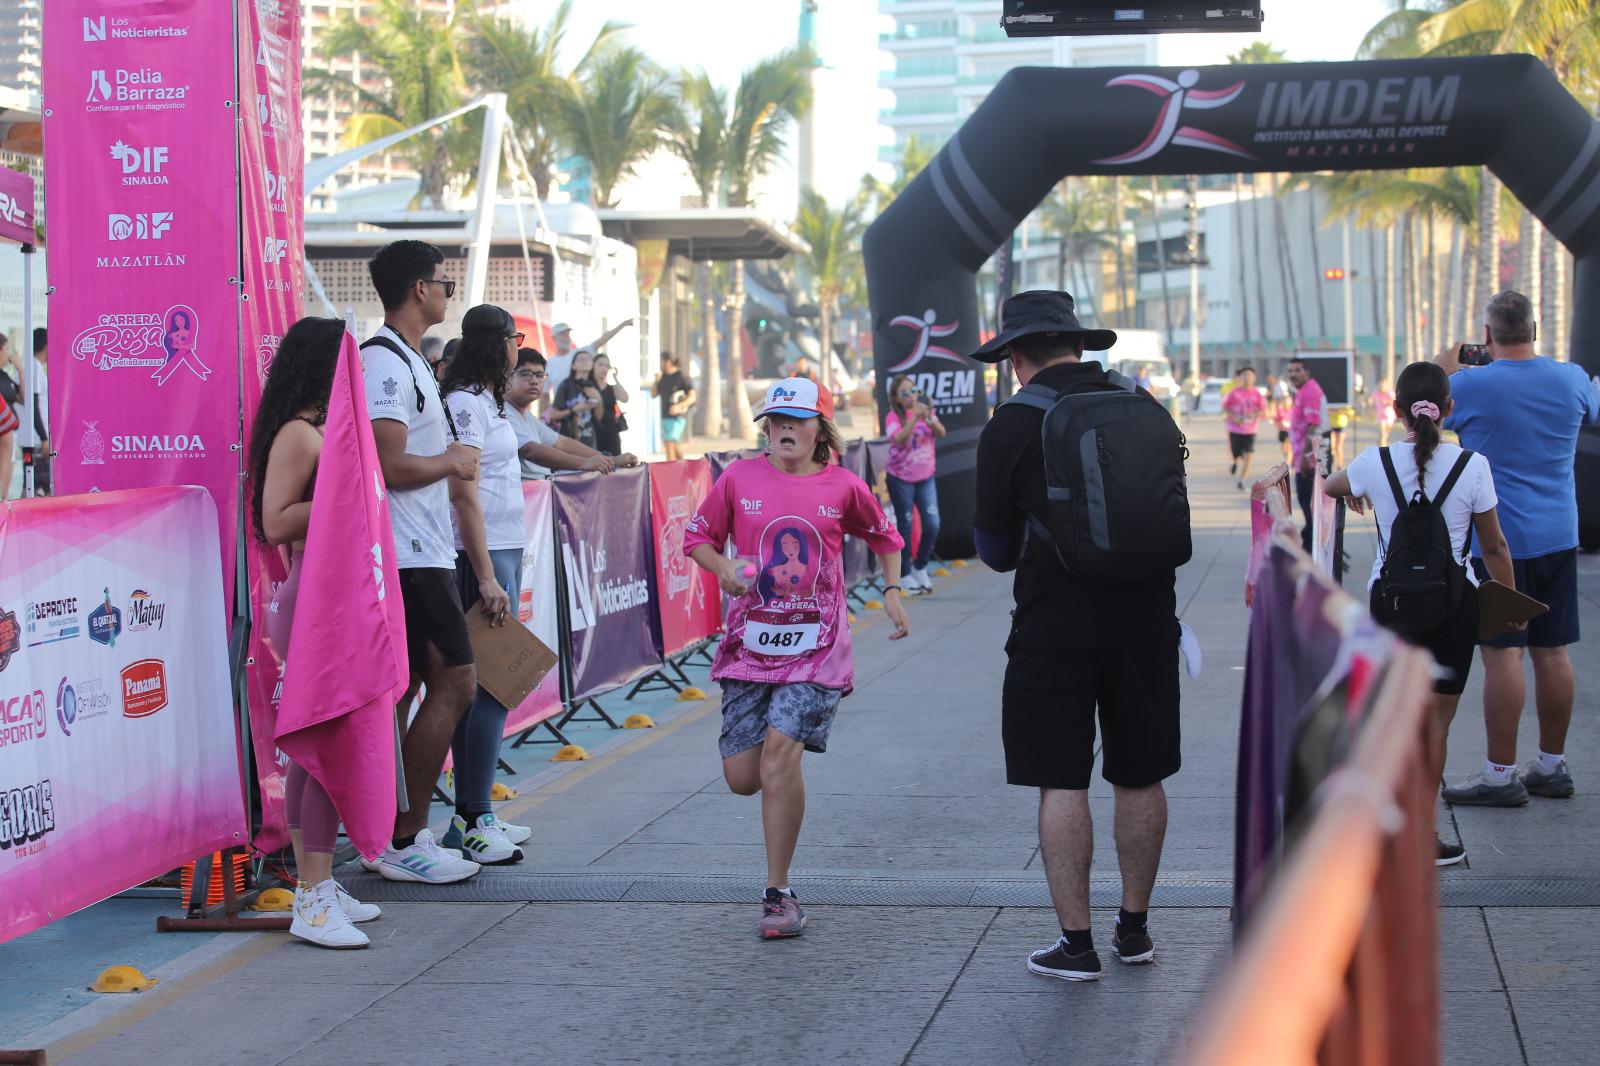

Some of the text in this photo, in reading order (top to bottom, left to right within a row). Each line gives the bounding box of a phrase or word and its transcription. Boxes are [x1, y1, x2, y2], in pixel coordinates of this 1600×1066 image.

[111, 17, 129, 26] Los
[111, 27, 188, 38] Noticieristas
[116, 68, 162, 84] Delia
[145, 102, 186, 111] diagnóstico
[1255, 75, 1461, 128] IMDEM
[1253, 125, 1450, 143] INSTITUTO MUNICIPAL DEL DEPORTE
[122, 146, 169, 174] DIF
[122, 175, 170, 186] SINALOA
[108, 211, 174, 241] DIF
[98, 314, 163, 326] CARRERA
[111, 434, 206, 452] SINALOA
[744, 499, 762, 511] DIF
[770, 600, 815, 610] CARRERA
[129, 598, 166, 631] Matuy
[758, 631, 804, 647] 0487
[125, 671, 162, 697] Panamá
